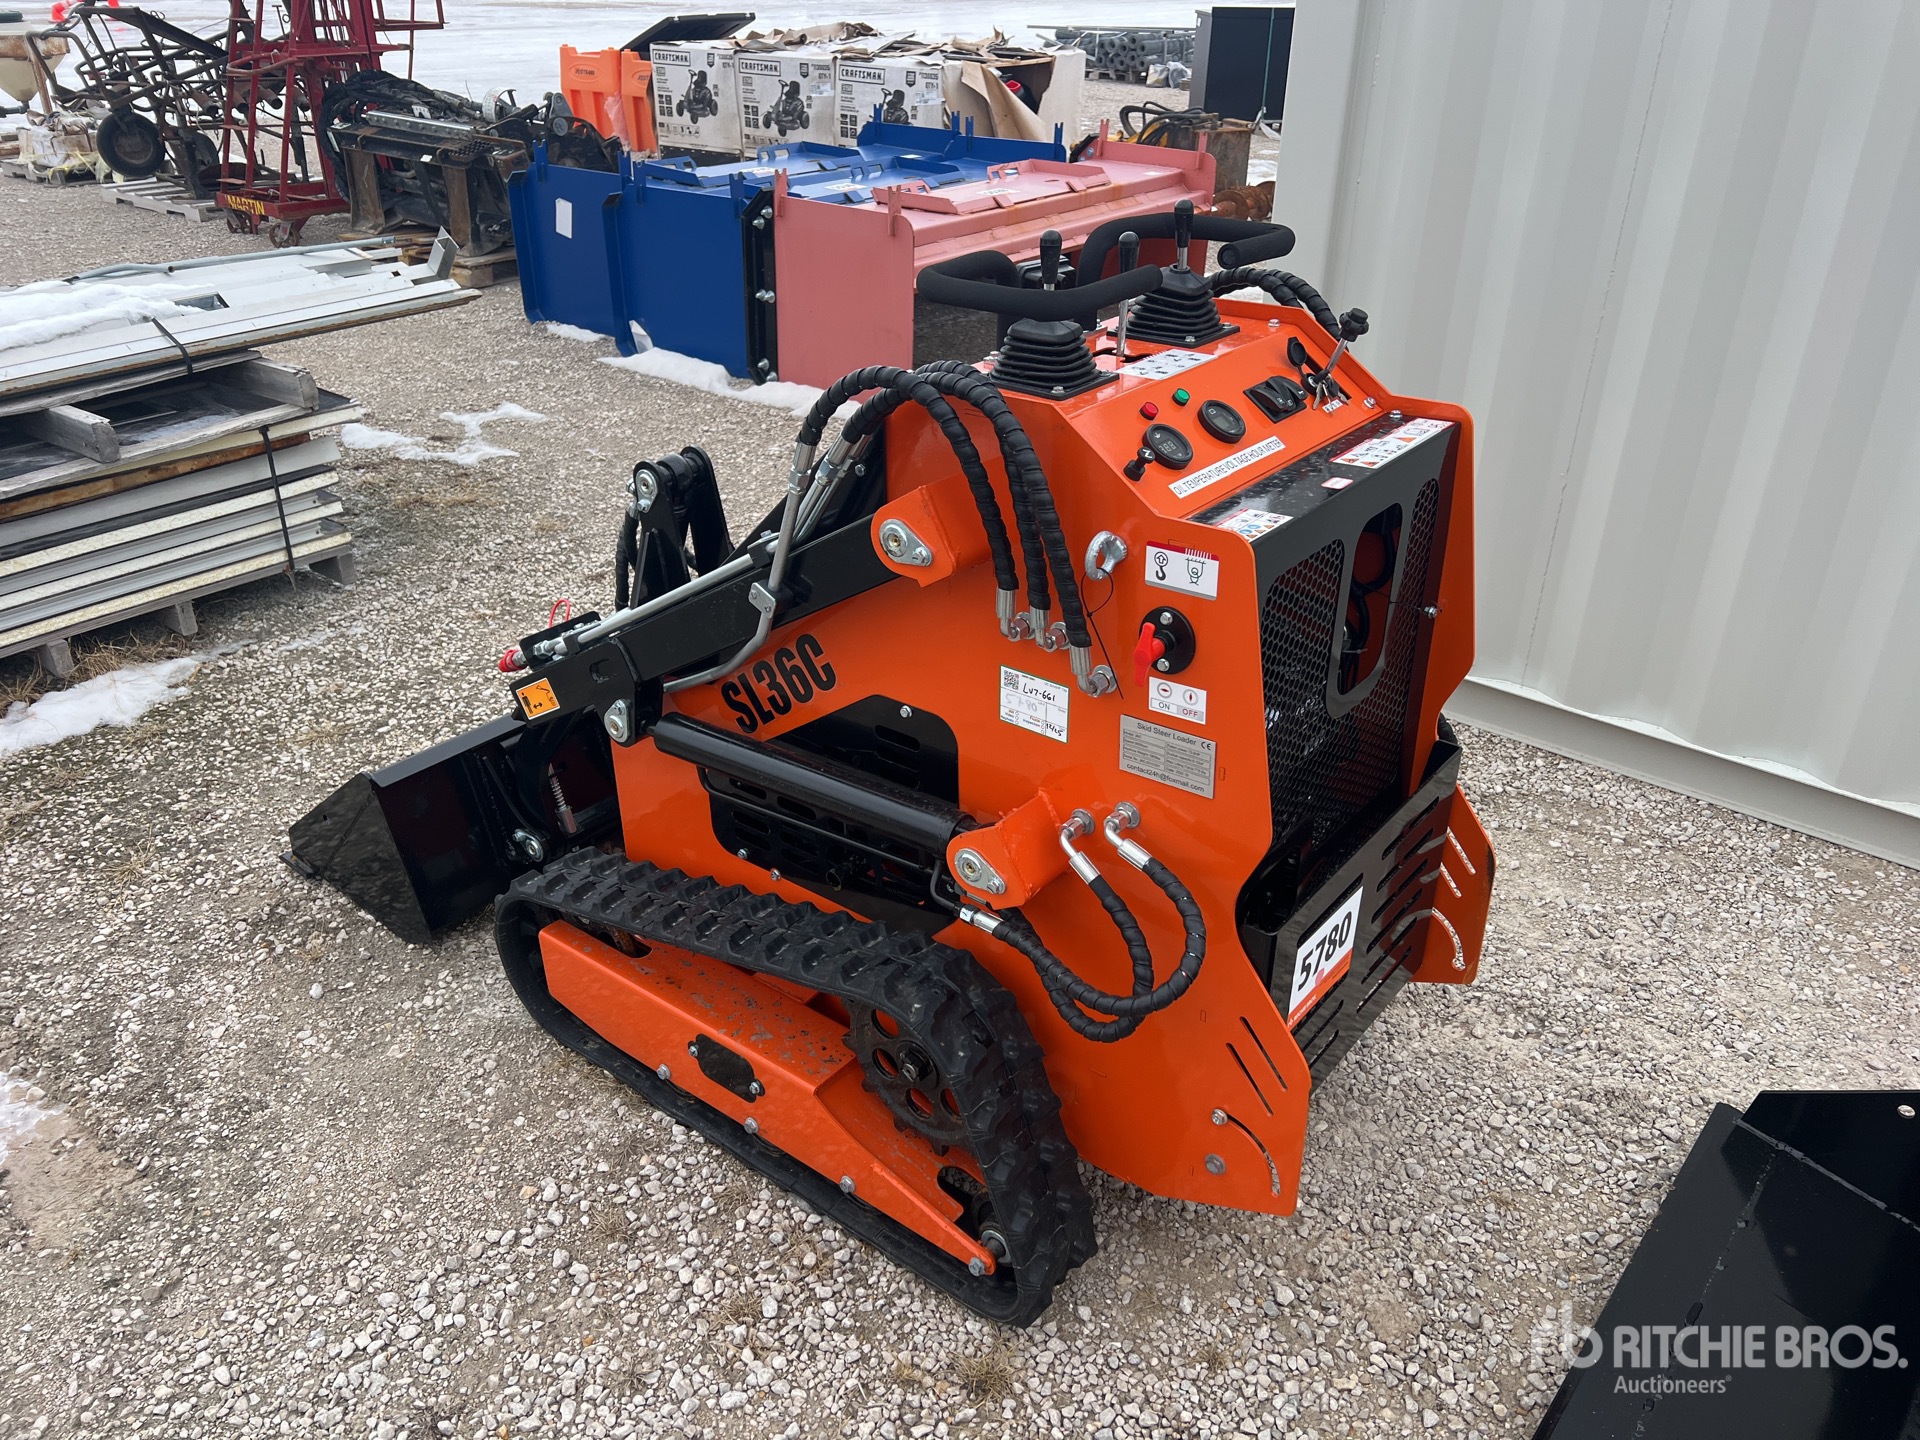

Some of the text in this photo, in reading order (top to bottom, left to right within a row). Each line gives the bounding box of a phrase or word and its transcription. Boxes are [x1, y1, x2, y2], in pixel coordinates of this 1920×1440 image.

[654, 52, 689, 63] CRAFTSMAN
[741, 61, 779, 76] CRAFTSMAN
[841, 68, 883, 81] CRAFTSMAN
[227, 195, 265, 215] MARTIN
[1185, 464, 1228, 490] TEMPERATURE
[1226, 452, 1252, 472] VOLTAGE
[1248, 446, 1266, 460] HOUR
[721, 634, 836, 733] SL36C
[1158, 701, 1170, 710] ON
[1182, 708, 1198, 718] OFF
[1137, 722, 1152, 733] Skid
[1153, 727, 1171, 739] Steer
[1173, 732, 1197, 746] Loader
[1200, 741, 1211, 751] CE
[1126, 763, 1205, 793] contact24h@foxmail.com
[1298, 911, 1352, 991] 5780
